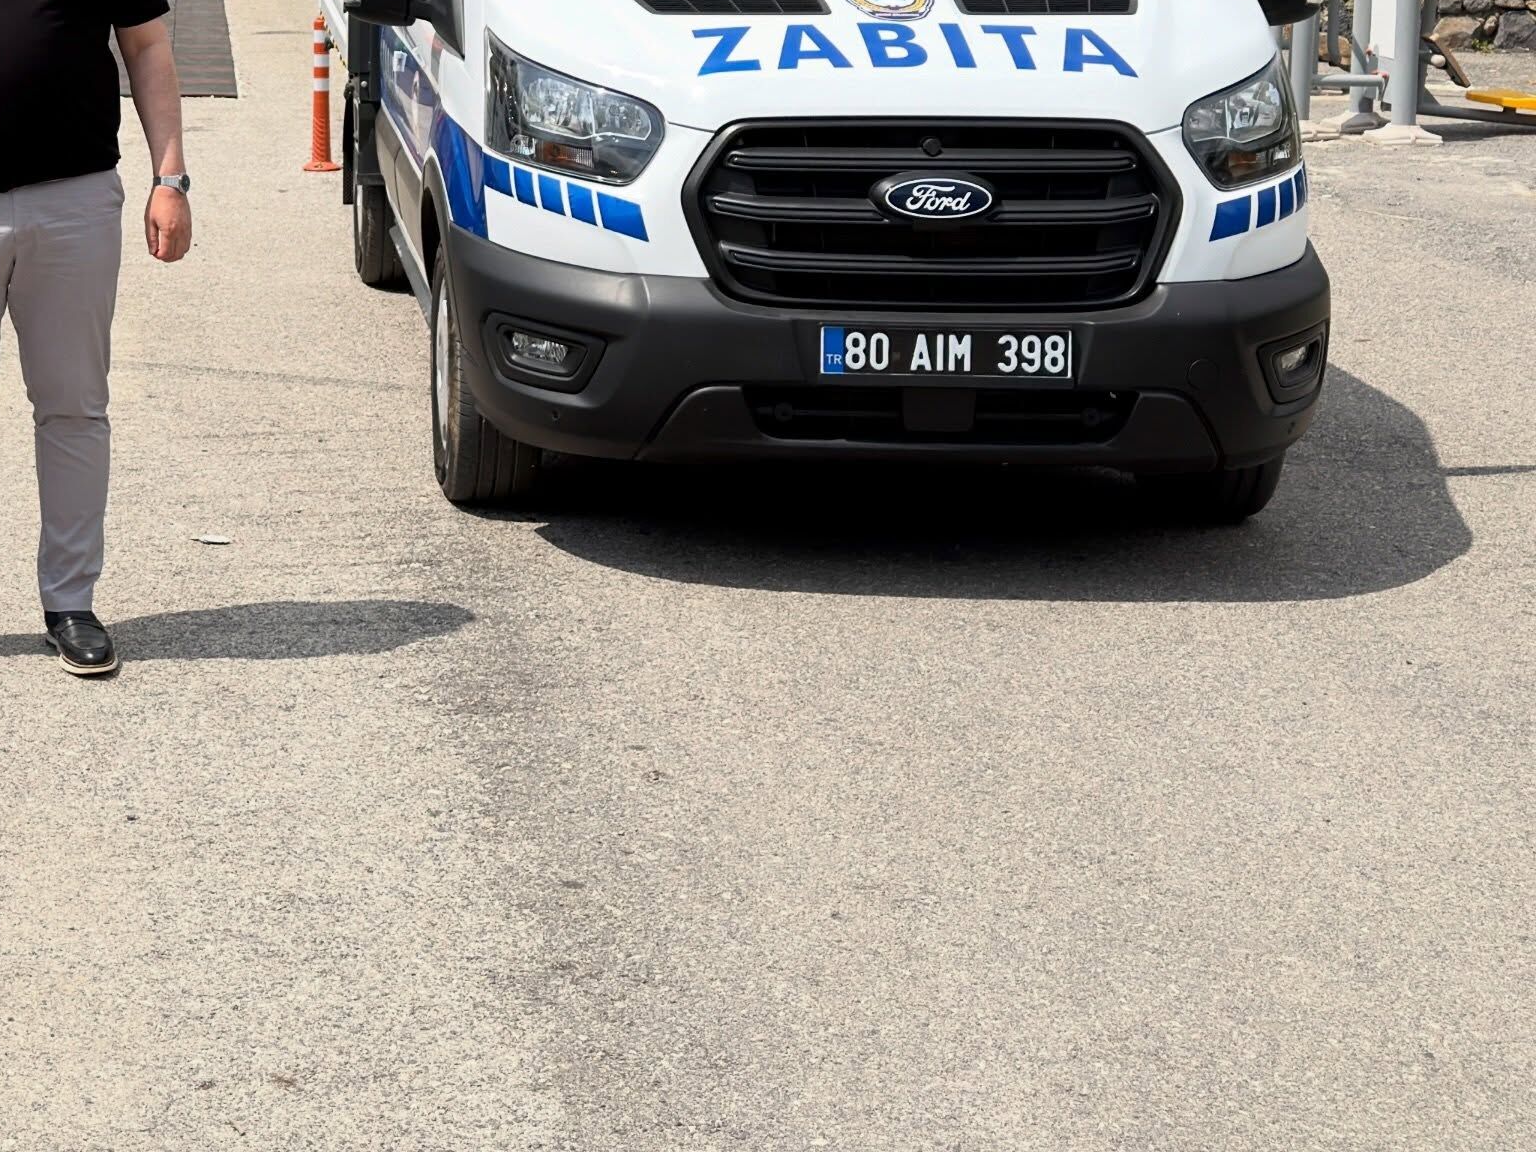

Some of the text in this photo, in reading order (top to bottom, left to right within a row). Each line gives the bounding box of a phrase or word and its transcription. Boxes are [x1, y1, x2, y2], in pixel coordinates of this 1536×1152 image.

[692, 22, 1139, 78] ZABITA
[905, 184, 972, 211] Ford
[826, 332, 1065, 373] TR 80 AIM 398
